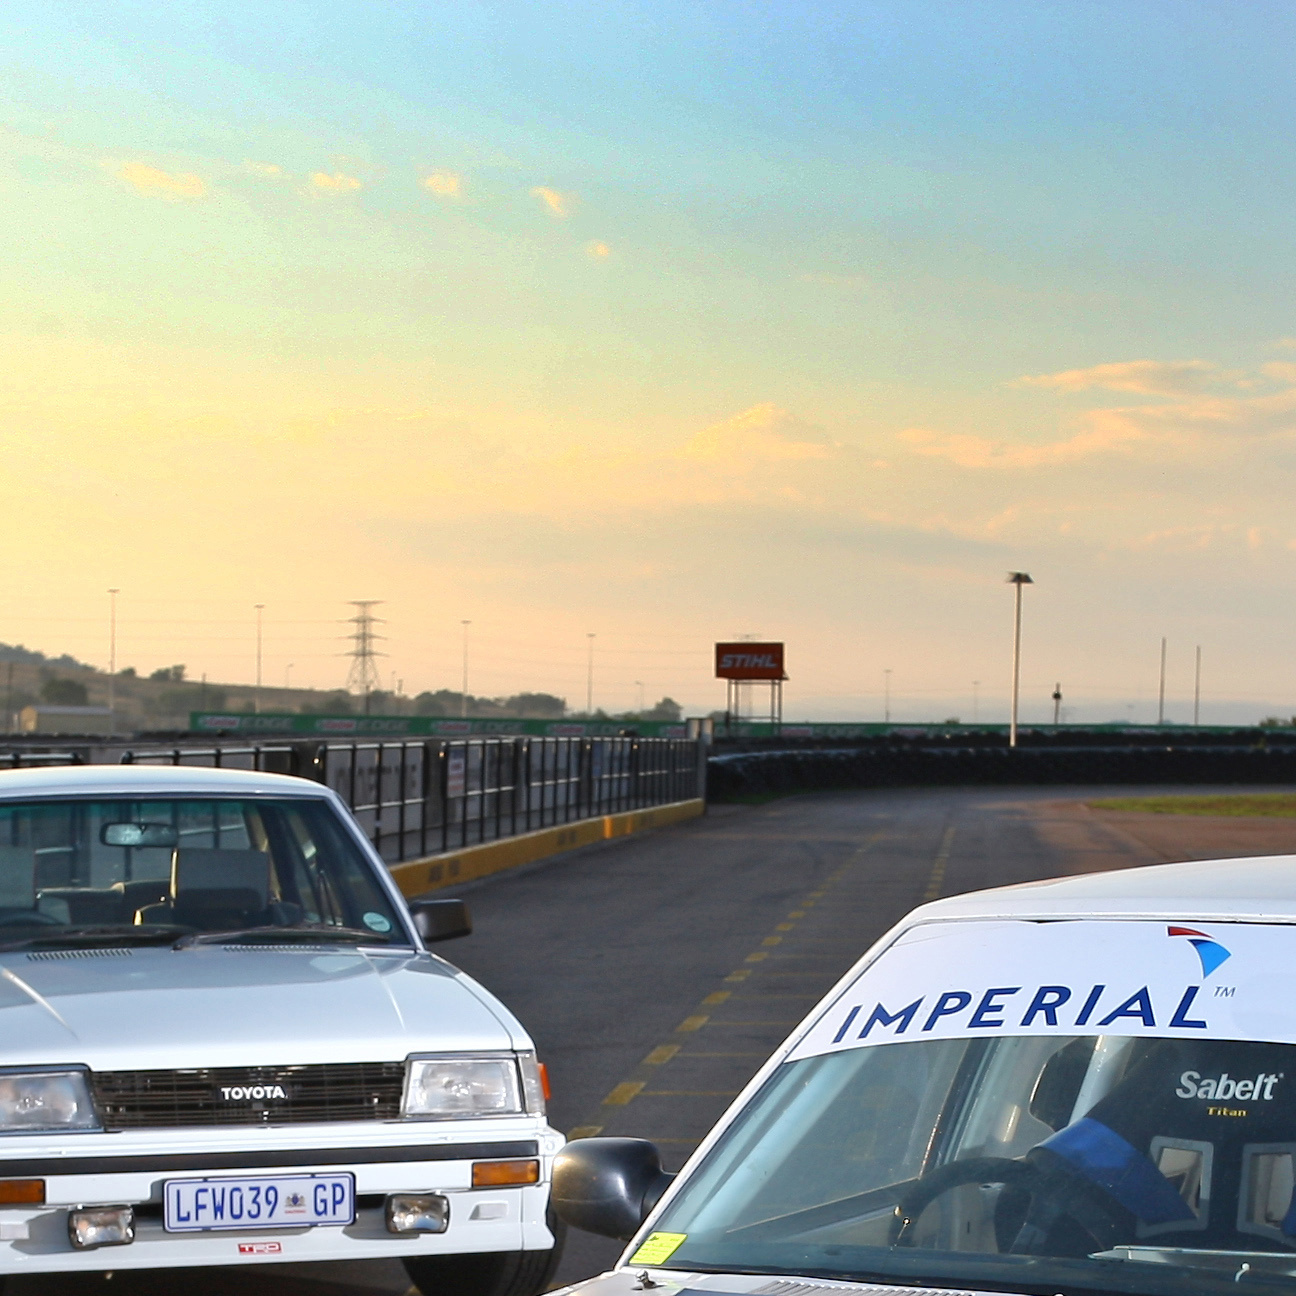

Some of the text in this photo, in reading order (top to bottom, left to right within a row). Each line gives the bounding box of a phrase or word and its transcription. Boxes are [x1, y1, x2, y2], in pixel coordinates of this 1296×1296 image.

[720, 653, 778, 668] STIHL
[830, 984, 1208, 1044] IMPERIAL
[220, 1085, 285, 1101] TOYOTA
[1175, 1070, 1279, 1101] Sabelt
[1207, 1106, 1248, 1118] Titan
[176, 1183, 345, 1223] LFW039 GP
